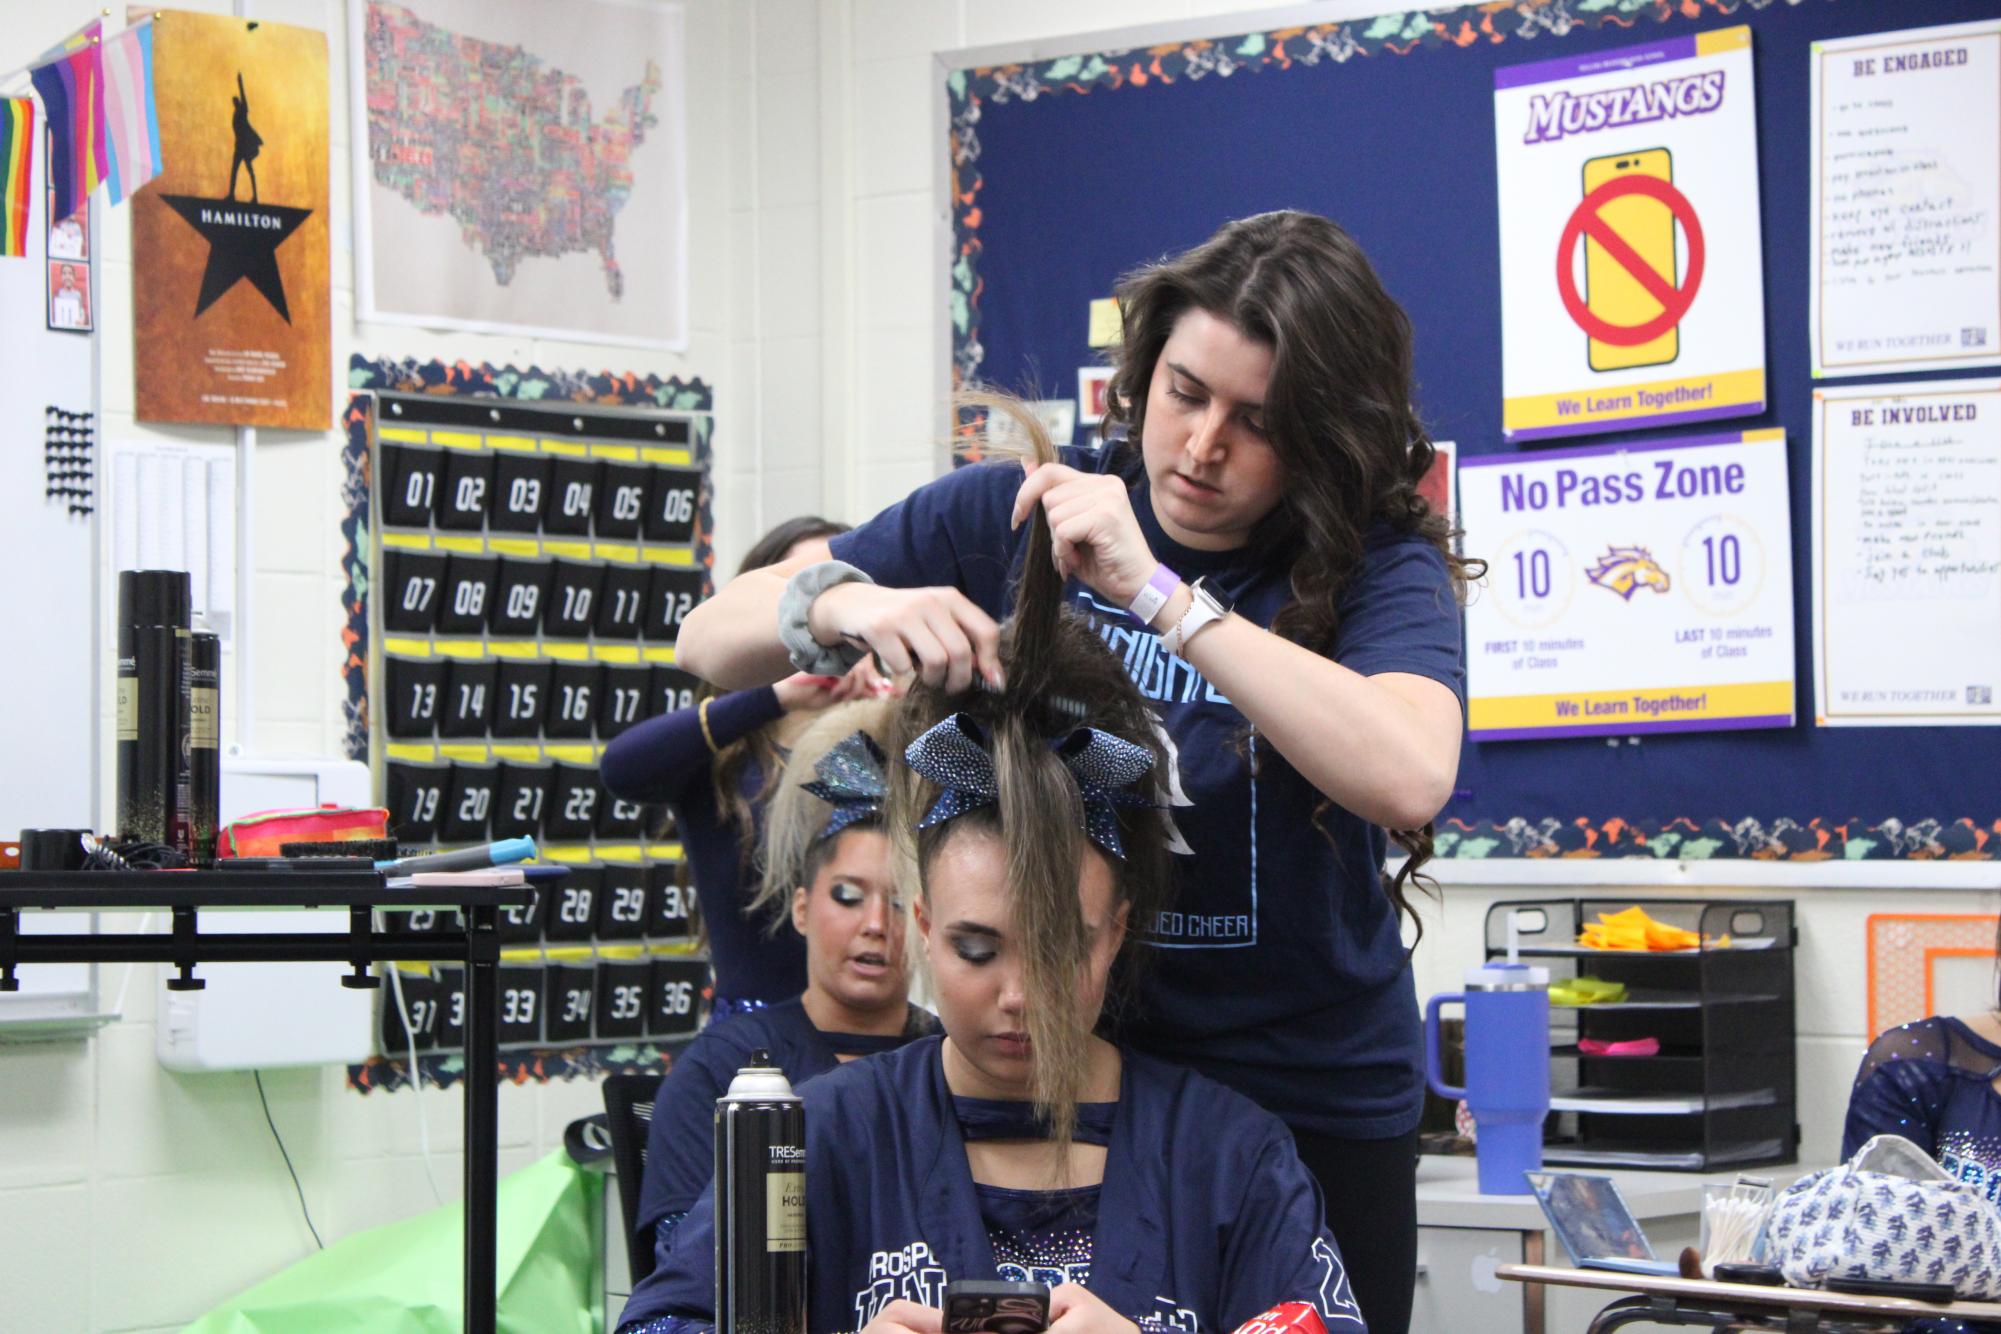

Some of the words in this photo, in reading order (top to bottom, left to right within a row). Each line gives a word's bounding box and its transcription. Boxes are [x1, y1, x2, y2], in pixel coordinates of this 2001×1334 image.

[1853, 59, 1875, 77] BE
[1883, 48, 1968, 73] ENGAGED
[1524, 70, 1725, 144] MUSTANGS
[202, 208, 281, 230] HAMILTON
[1557, 398, 1581, 416] We
[1587, 395, 1632, 413] Learn
[1638, 382, 1712, 409] Together!
[1851, 409, 1874, 427] BE
[1882, 403, 1977, 425] INVOLVED
[406, 472, 434, 508] 01
[456, 477, 485, 511] 02
[509, 479, 540, 512] 03
[564, 482, 592, 517] 04
[613, 486, 642, 520] 05
[664, 489, 694, 523] 06
[1501, 473, 1548, 512] No
[1556, 469, 1644, 508] Pass
[1654, 460, 1746, 500] Zone
[1513, 549, 1550, 599] 10
[1702, 534, 1741, 586] 10
[403, 577, 436, 612] 07
[455, 581, 485, 615] 08
[507, 584, 538, 619] 09
[563, 586, 592, 621] 10
[614, 590, 639, 623] 11
[664, 592, 692, 625] 12
[1485, 640, 1518, 654] FIRST
[1523, 639, 1536, 652] 10
[1539, 637, 1585, 651] minutes
[1675, 628, 1705, 644] LAST
[1709, 627, 1723, 641] 10
[1725, 625, 1772, 639] minutes
[1701, 645, 1714, 659] of
[1716, 644, 1747, 658] Class
[1512, 657, 1525, 670] of
[1527, 656, 1558, 669] Class
[191, 704, 211, 714] OLD
[411, 684, 437, 719] 13
[459, 684, 485, 719] 14
[510, 684, 538, 719] 15
[563, 686, 591, 721] 16
[615, 688, 640, 723] 17
[1555, 700, 1579, 717] We
[1585, 698, 1628, 715] Learn
[1633, 693, 1707, 717] Together!
[412, 788, 440, 822] 19
[459, 788, 490, 821] 20
[514, 788, 543, 821] 21
[565, 788, 596, 821] 22
[561, 889, 592, 922] 28
[612, 887, 645, 922] 29
[1188, 914, 1248, 937] CHEER
[410, 1000, 437, 1034] 31
[449, 991, 465, 1026] 3
[503, 989, 536, 1023] 33
[563, 990, 591, 1022] 34
[611, 987, 642, 1019] 35
[662, 982, 692, 1014] 36
